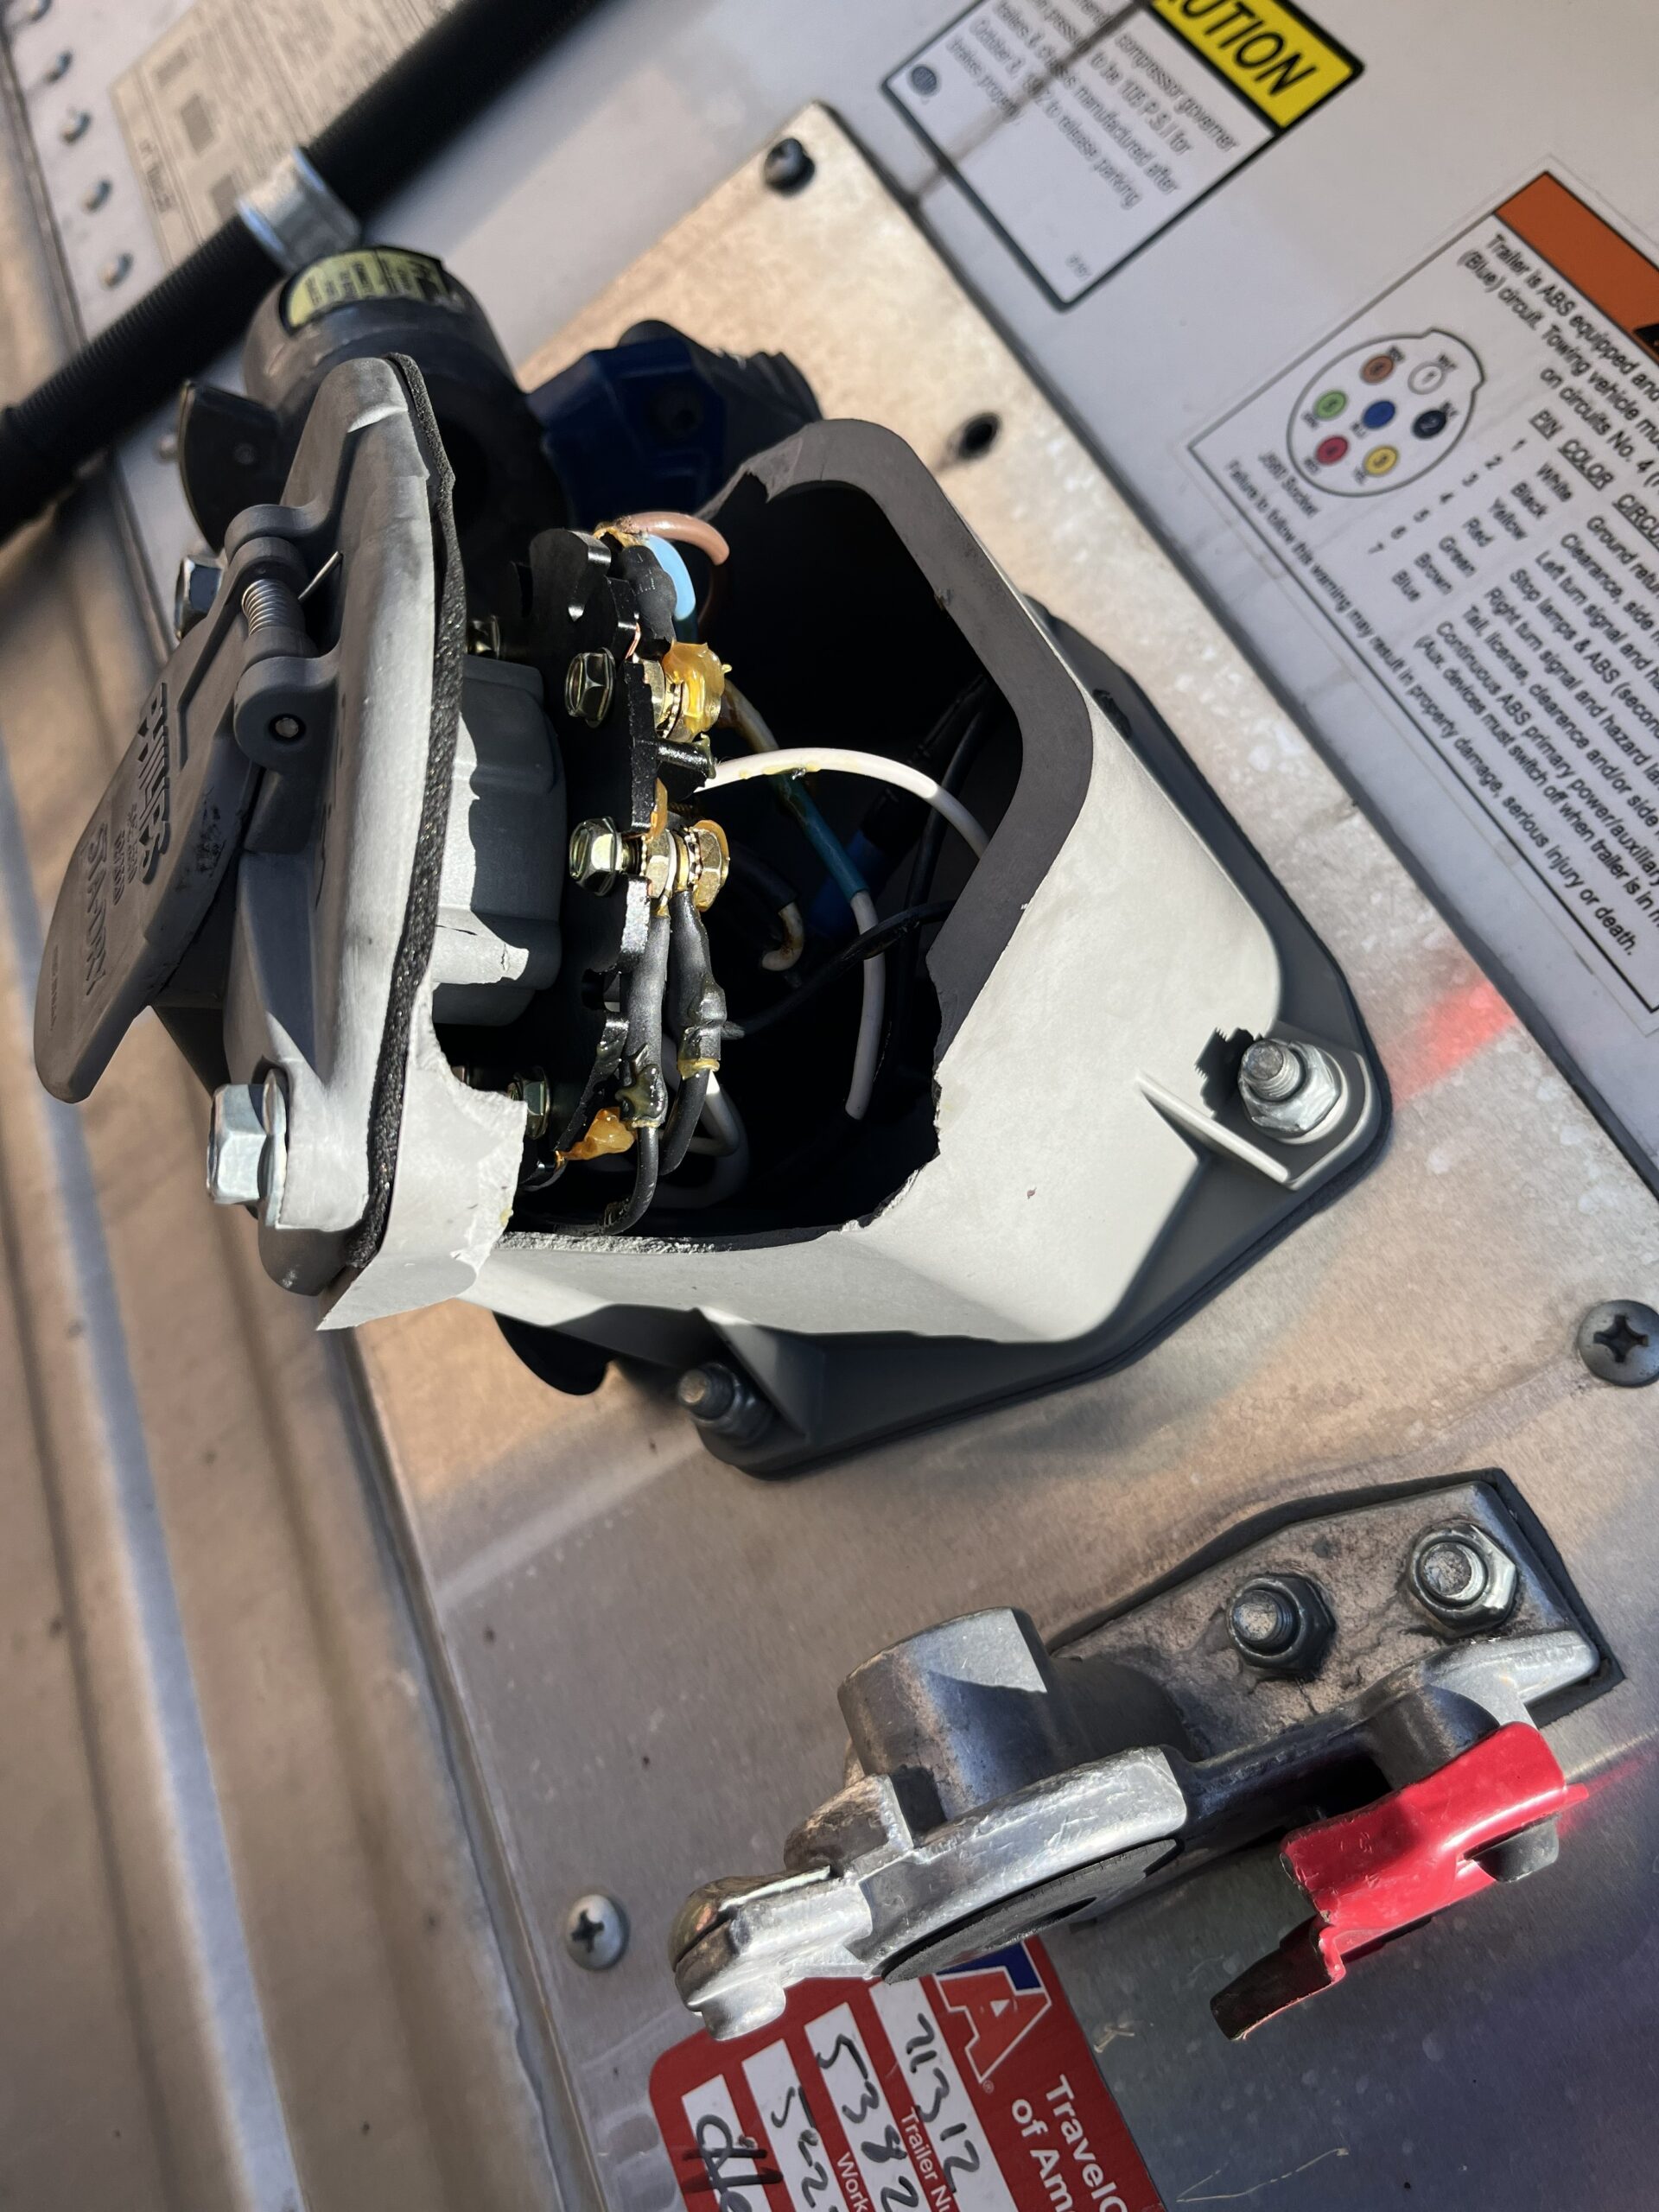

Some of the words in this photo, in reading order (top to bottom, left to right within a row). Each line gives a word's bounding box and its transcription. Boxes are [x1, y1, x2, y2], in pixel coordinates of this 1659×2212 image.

[1166, 0, 1317, 97] UTION
[1452, 245, 1509, 296] (Blue)
[1494, 282, 1550, 331] circuit.
[1534, 322, 1598, 379] Towing
[1583, 365, 1649, 424] vehicle
[1483, 232, 1535, 278] Trailer
[1522, 268, 1548, 289] is
[1535, 281, 1579, 319] ABS
[1562, 309, 1643, 380] equipped
[1536, 365, 1565, 391] on
[1555, 380, 1618, 438] circuits
[1605, 429, 1643, 463] No.
[1631, 454, 1656, 476] 4
[1529, 407, 1565, 440] PIN
[1556, 435, 1618, 492] COLOR
[1222, 458, 1264, 503] Failure
[1251, 494, 1274, 516] to
[1435, 488, 1456, 506] 4
[1262, 507, 1300, 546] follow
[1459, 515, 1497, 550] Red
[1483, 452, 1505, 472] 2
[1509, 480, 1554, 522] Black
[1555, 530, 1633, 606] Clearance,
[1620, 595, 1659, 633] side
[1532, 461, 1578, 505] White
[1582, 512, 1640, 567] Ground
[1288, 538, 1319, 569] this
[1304, 560, 1357, 616] warning
[1484, 496, 1533, 544] Yellow
[1532, 548, 1569, 582] Left
[1556, 574, 1593, 608] turn
[1577, 599, 1630, 649] signal
[1617, 638, 1654, 672] and
[1503, 565, 1547, 606] Stop
[1342, 607, 1377, 643] may
[1530, 595, 1583, 647] lamps
[1571, 635, 1594, 655] &
[1366, 631, 1408, 674] result
[1395, 665, 1417, 686] in
[1434, 532, 1482, 580] Green
[1478, 584, 1525, 629] Right
[1512, 619, 1548, 654] turn
[1534, 645, 1585, 696] signal
[1572, 684, 1609, 720] and
[1597, 711, 1653, 769] hazard
[1581, 646, 1623, 686] ABS
[1365, 540, 1385, 558] 7
[1389, 568, 1426, 605] Blue
[1433, 619, 1506, 697] Continuous
[1494, 690, 1533, 728] ABS
[1519, 721, 1580, 784] primary
[1566, 773, 1659, 889] power/auxiliary
[1404, 680, 1462, 743] property
[1412, 550, 1458, 597] Brown
[1457, 603, 1495, 639] Tail,
[1480, 629, 1537, 688] license,
[1526, 679, 1595, 752] clearence
[1583, 743, 1637, 798] and/or
[1624, 790, 1659, 830] side
[137, 682, 171, 885] PHILLIPS
[1440, 664, 1491, 717] devices
[1478, 709, 1517, 749] must
[1505, 741, 1553, 789] switch
[1541, 782, 1569, 809] off
[1555, 798, 1599, 844] when
[1587, 836, 1634, 884] trailer
[1620, 875, 1645, 898] is
[1633, 889, 1658, 913] in
[1447, 733, 1511, 802] damage,
[1499, 791, 1554, 849] serious
[1539, 842, 1589, 894] injury
[1576, 885, 1601, 910] or
[1591, 901, 1644, 958] death.
[899, 2106, 940, 2183] Trailer
[1010, 2097, 1049, 2139] of
[1028, 2146, 1078, 2212] Am
